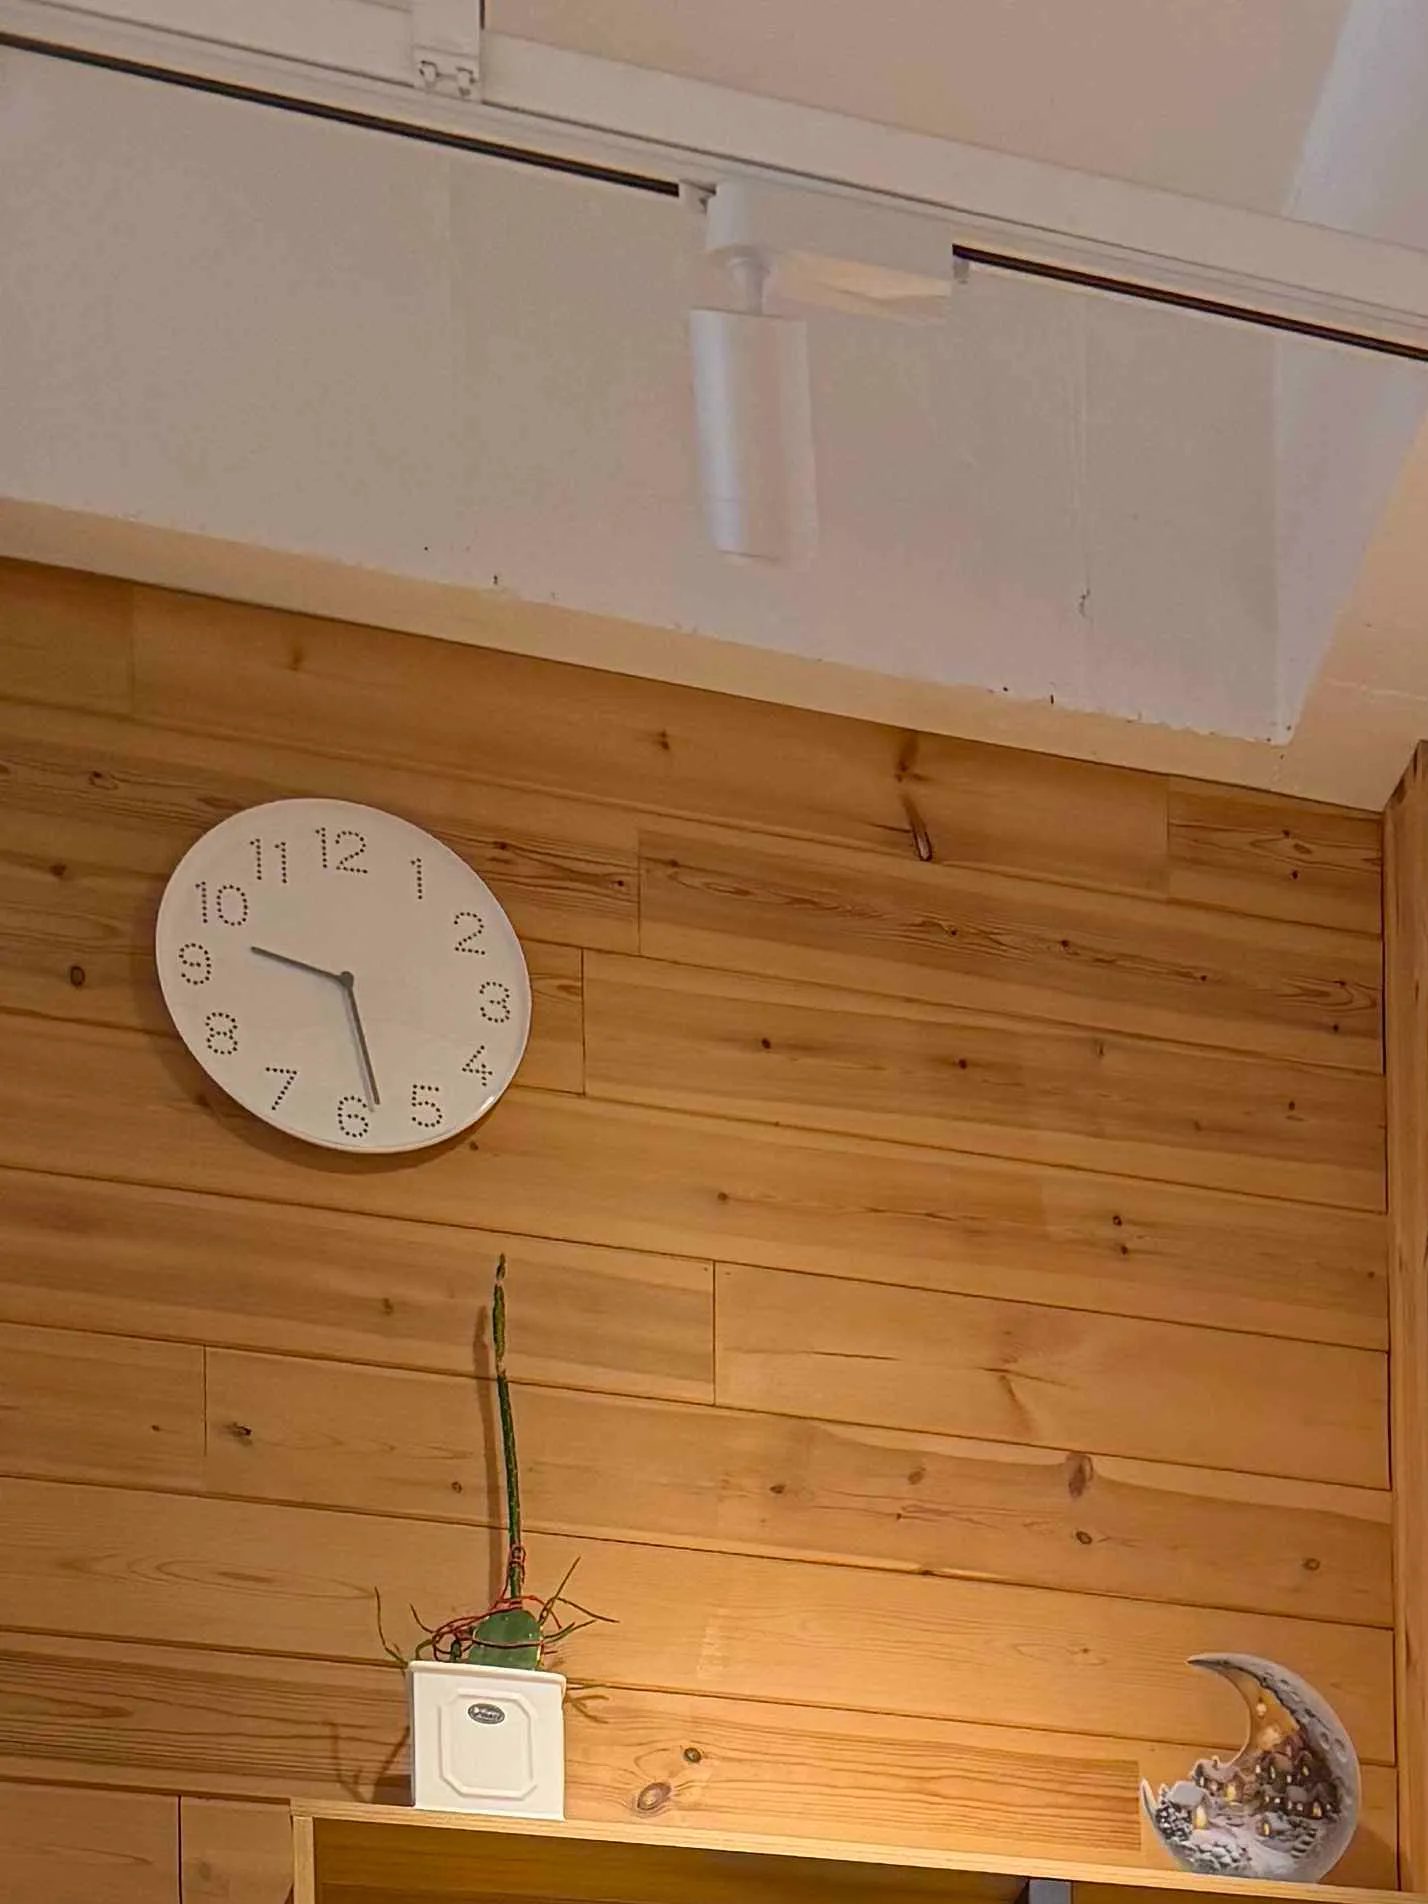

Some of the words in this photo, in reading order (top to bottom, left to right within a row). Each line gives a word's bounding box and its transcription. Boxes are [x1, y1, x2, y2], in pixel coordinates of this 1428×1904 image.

[249, 838, 287, 884] 11
[315, 826, 368, 874] 12
[410, 857, 423, 900] 1
[195, 881, 249, 927] 10
[453, 911, 486, 956] 2
[178, 942, 212, 985] 9
[479, 980, 511, 1024] 3
[205, 1011, 238, 1056] 8
[461, 1044, 493, 1087] 4
[265, 1066, 298, 1111] 7
[411, 1083, 443, 1128] 5
[336, 1095, 369, 1138] 6
